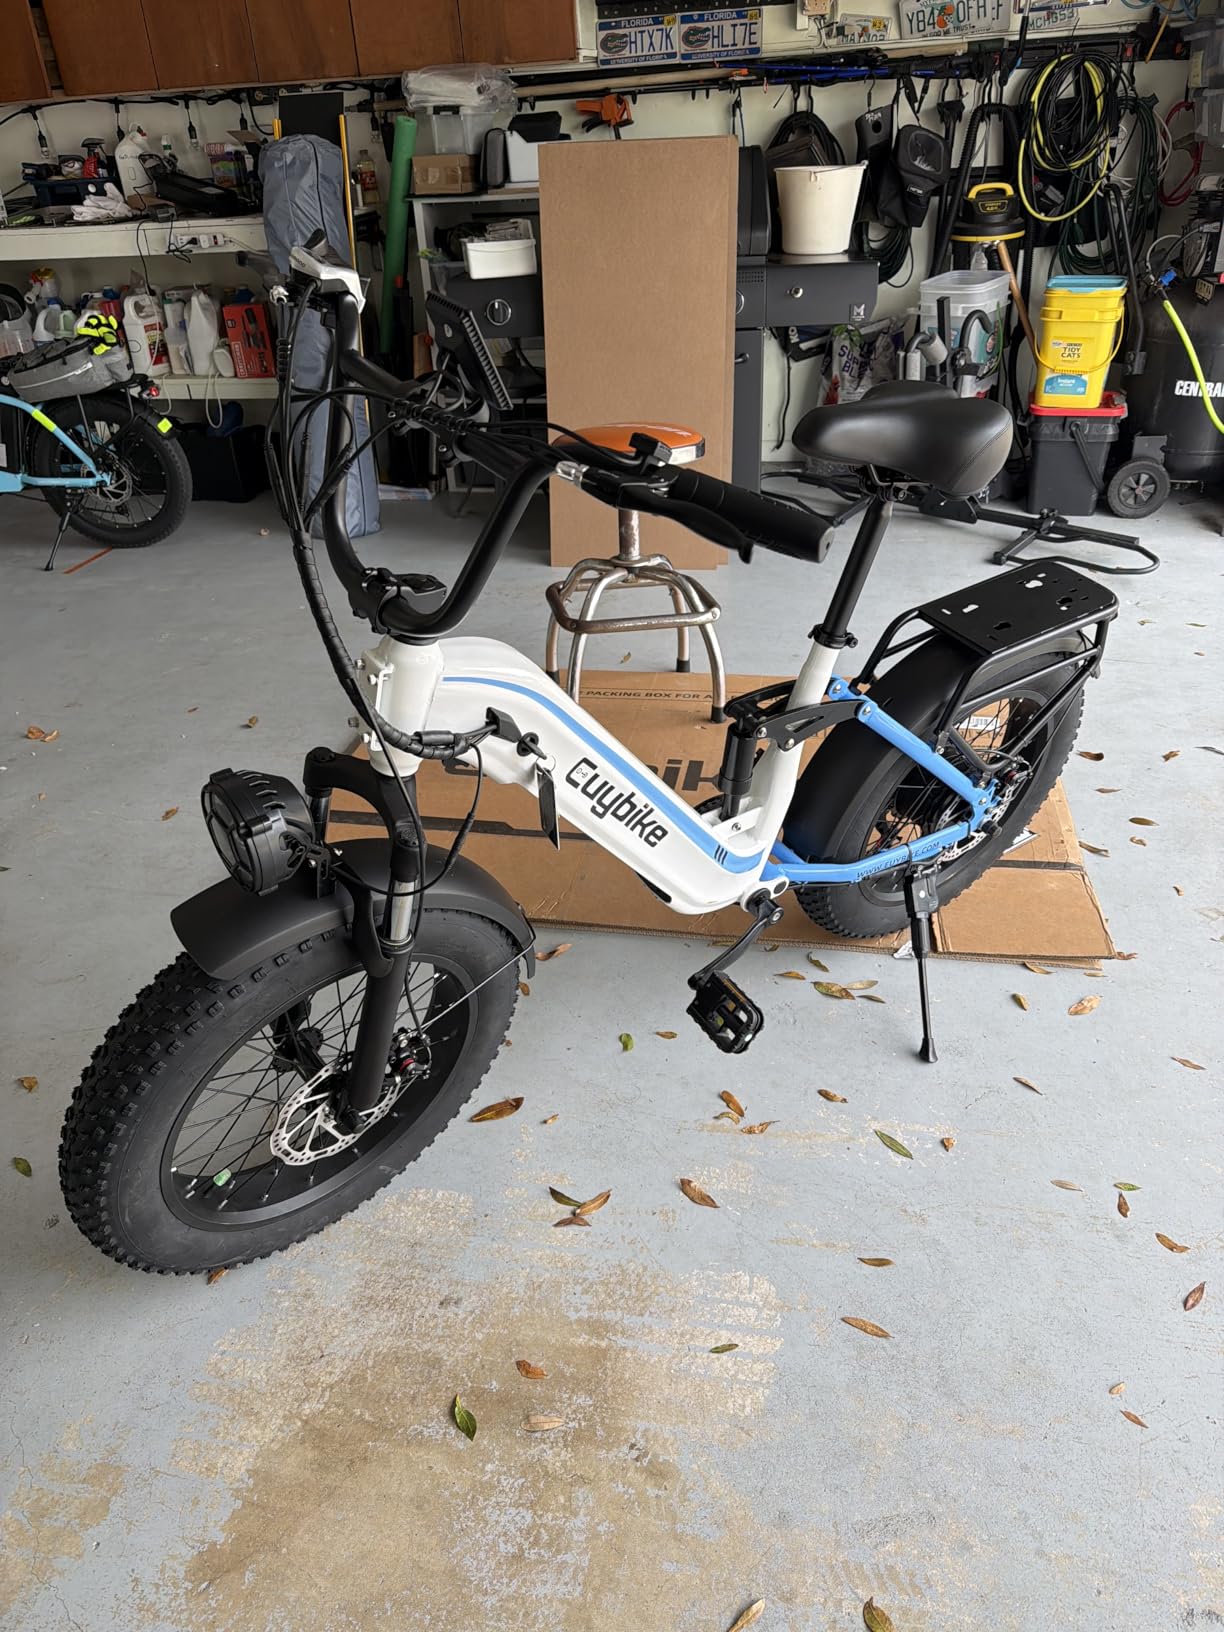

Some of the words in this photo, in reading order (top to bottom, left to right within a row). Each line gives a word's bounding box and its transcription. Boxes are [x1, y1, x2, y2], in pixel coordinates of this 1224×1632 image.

[704, 11, 738, 21] FLORIDA
[906, 6, 936, 35] Y84
[621, 18, 654, 28] FLORIDA
[628, 27, 674, 54] HTX7K
[586, 690, 641, 698] PACKING
